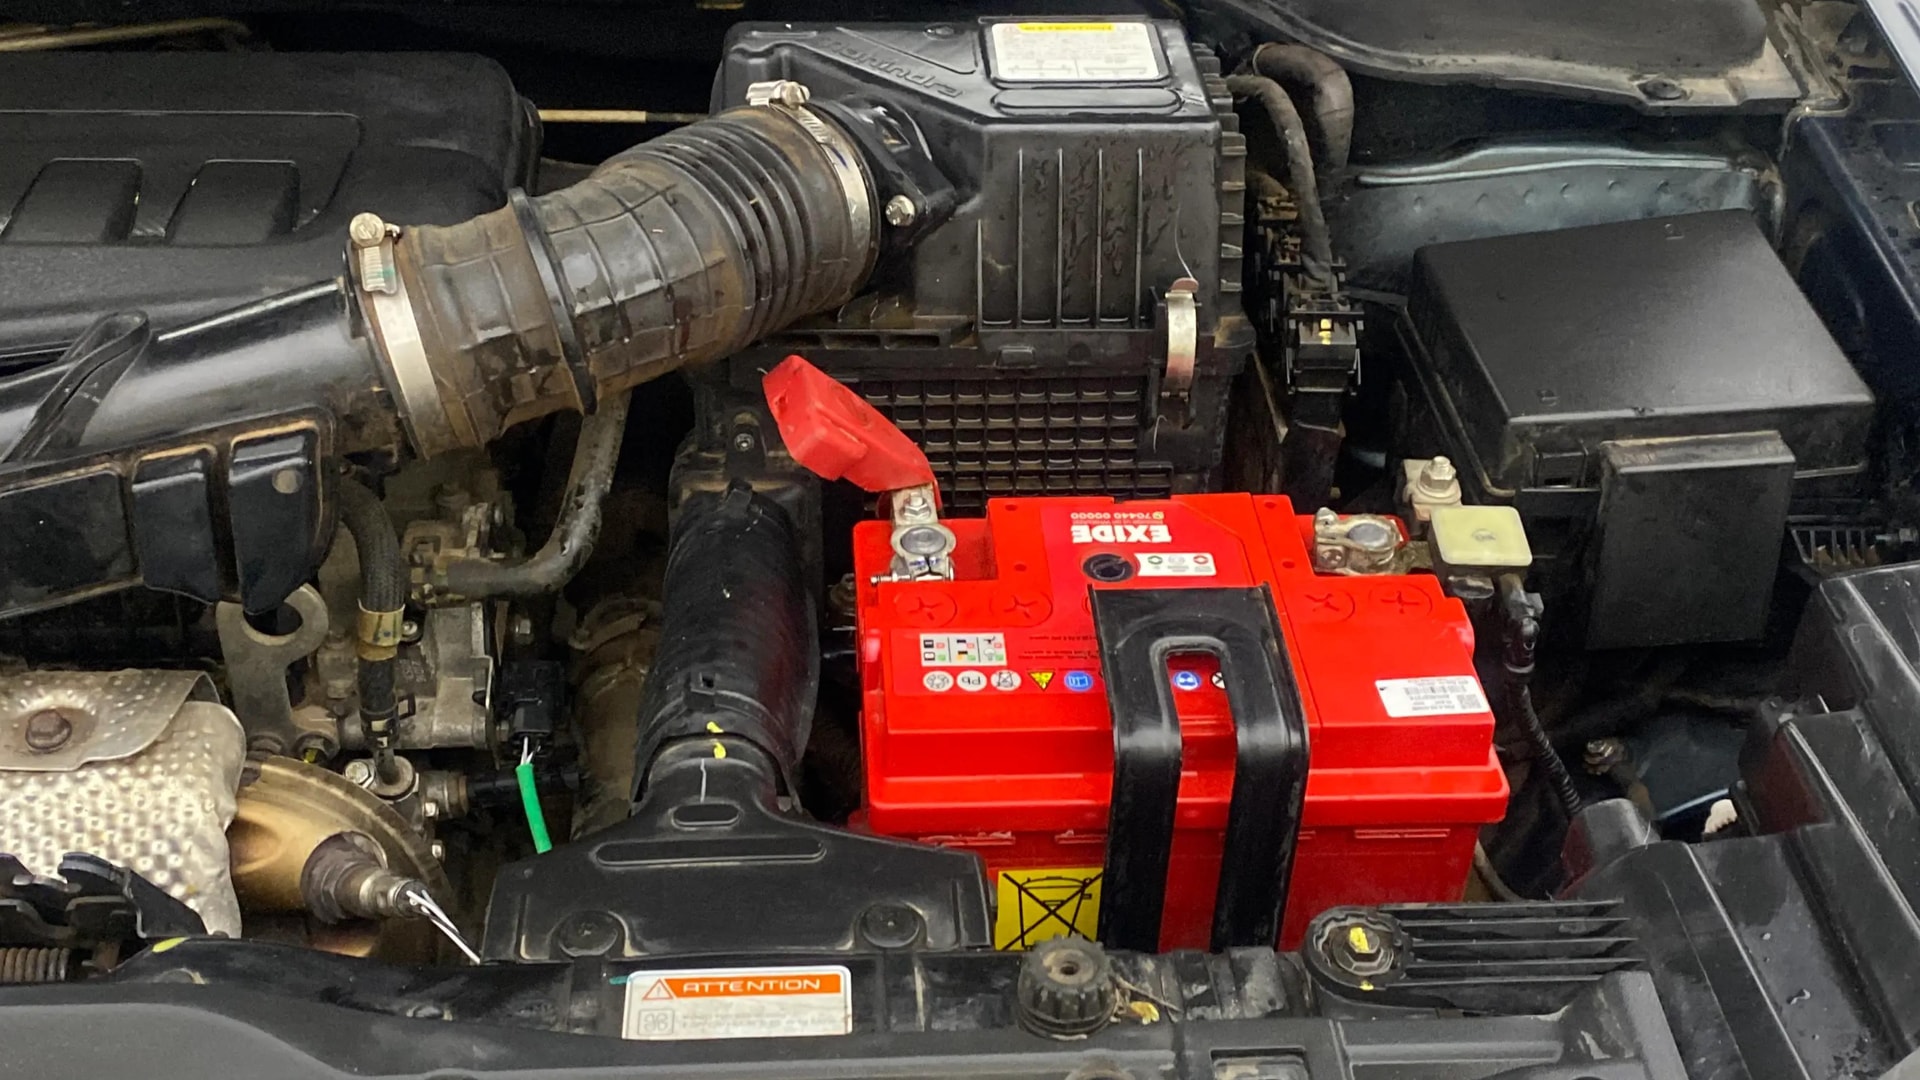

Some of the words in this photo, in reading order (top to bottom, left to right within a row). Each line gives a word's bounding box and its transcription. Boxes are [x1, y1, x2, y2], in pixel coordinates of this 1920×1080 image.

[1071, 512, 1111, 520] 00000
[1071, 524, 1171, 543] EXIDE
[961, 675, 982, 686] Pb
[682, 978, 821, 994] ATTENTION
